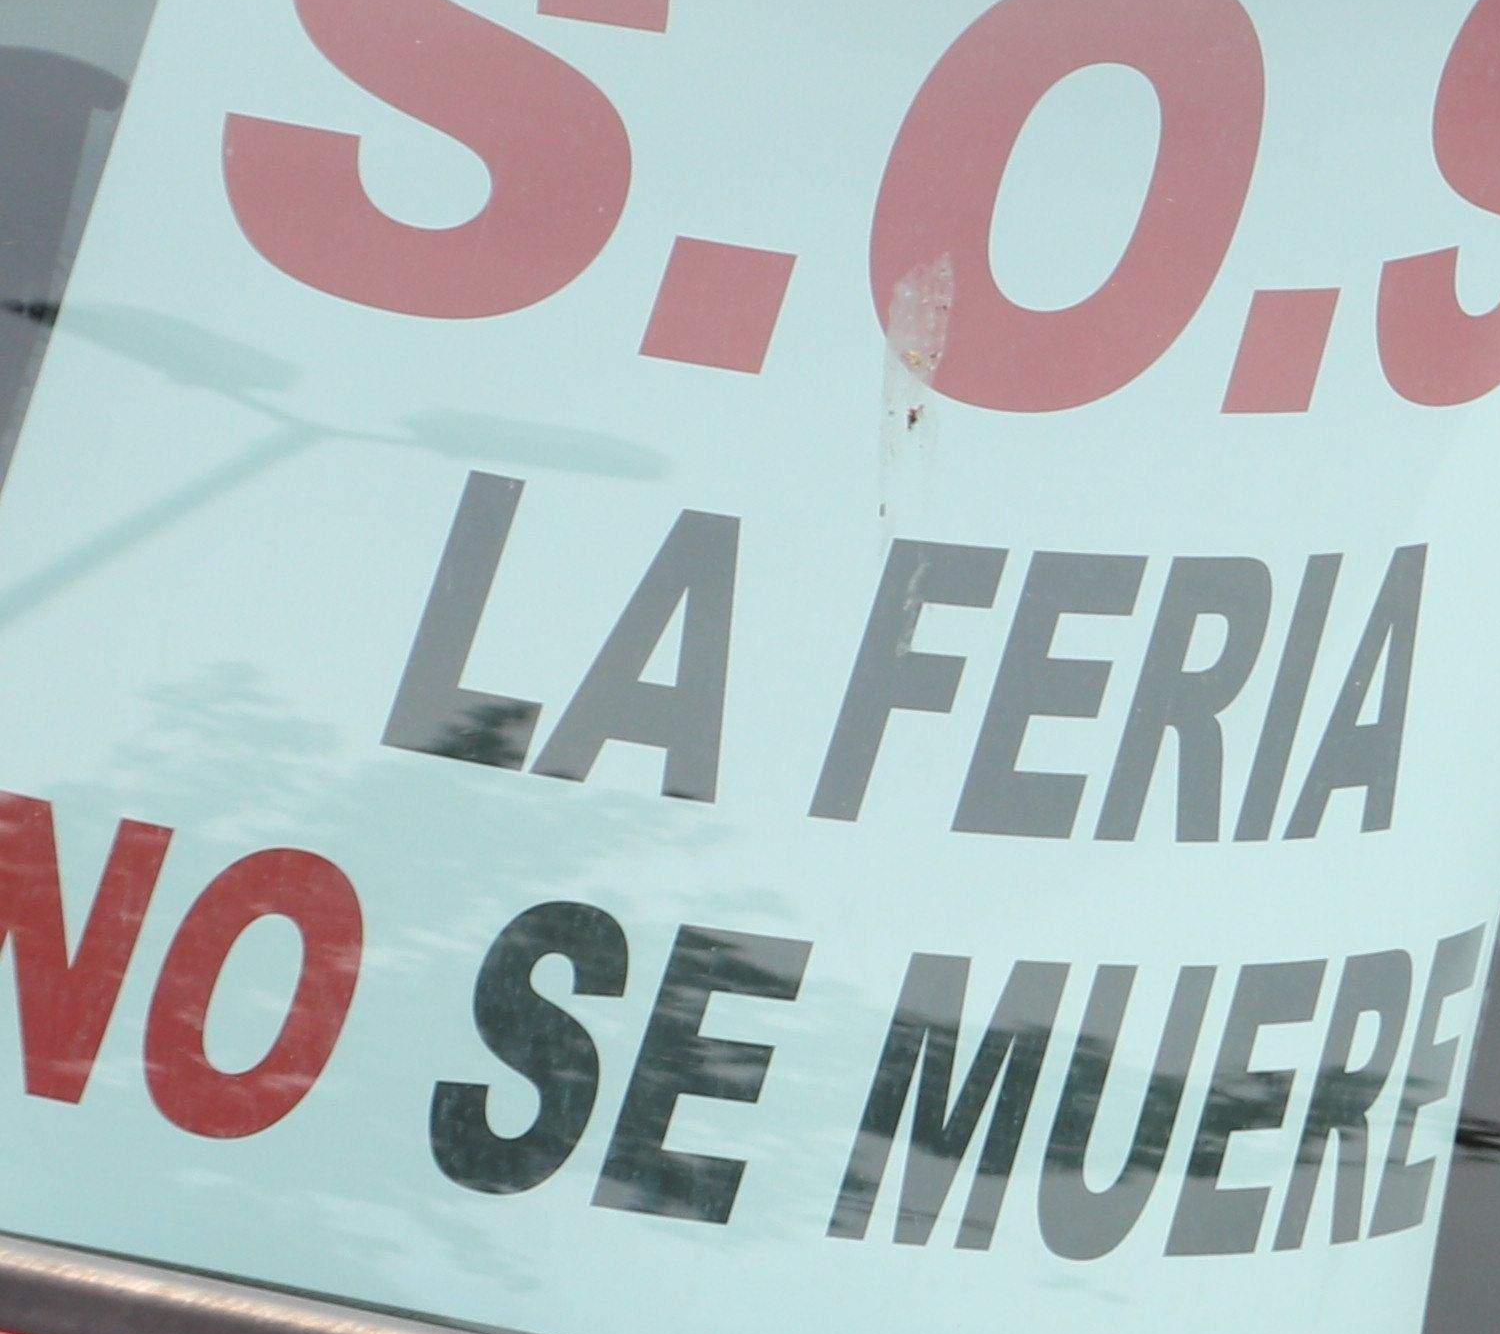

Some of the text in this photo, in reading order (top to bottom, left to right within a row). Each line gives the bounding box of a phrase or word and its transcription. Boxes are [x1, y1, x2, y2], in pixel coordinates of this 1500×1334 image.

[380, 469, 1429, 846] LA FERIA
[0, 790, 1488, 1262] NO SE MUERE
